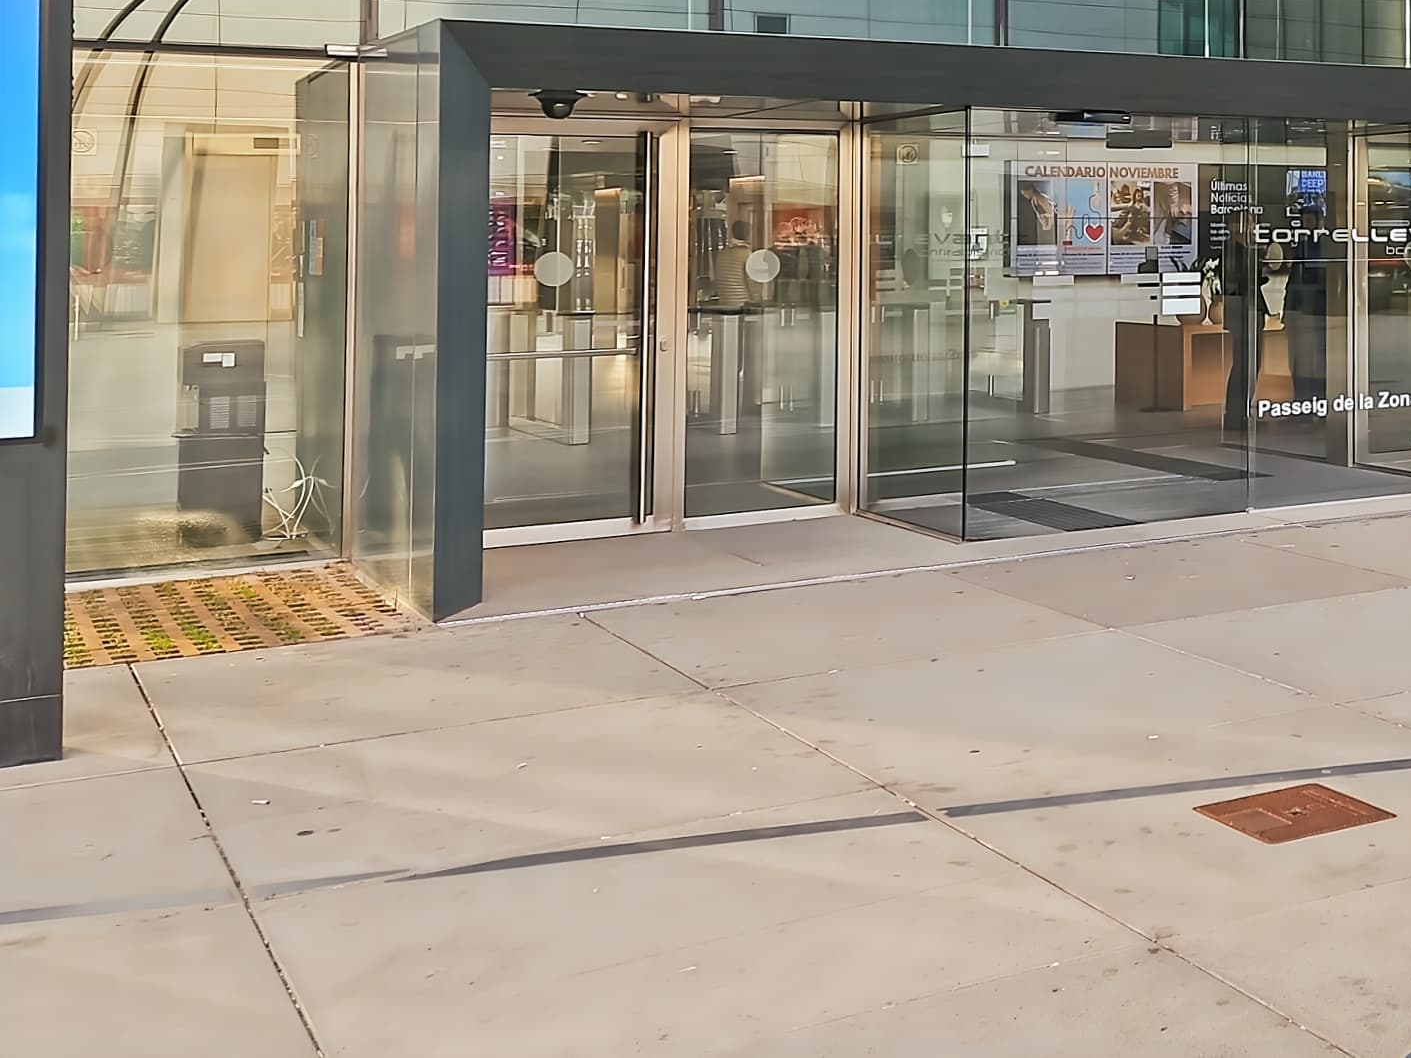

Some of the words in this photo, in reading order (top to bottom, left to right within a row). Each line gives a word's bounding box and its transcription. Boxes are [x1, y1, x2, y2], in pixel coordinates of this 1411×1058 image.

[1024, 165, 1105, 178] CALENDARIO
[1110, 167, 1179, 179] NOVIEMBRE
[1258, 396, 1328, 418] Passeig
[1333, 394, 1354, 412] de
[1359, 393, 1374, 410] la
